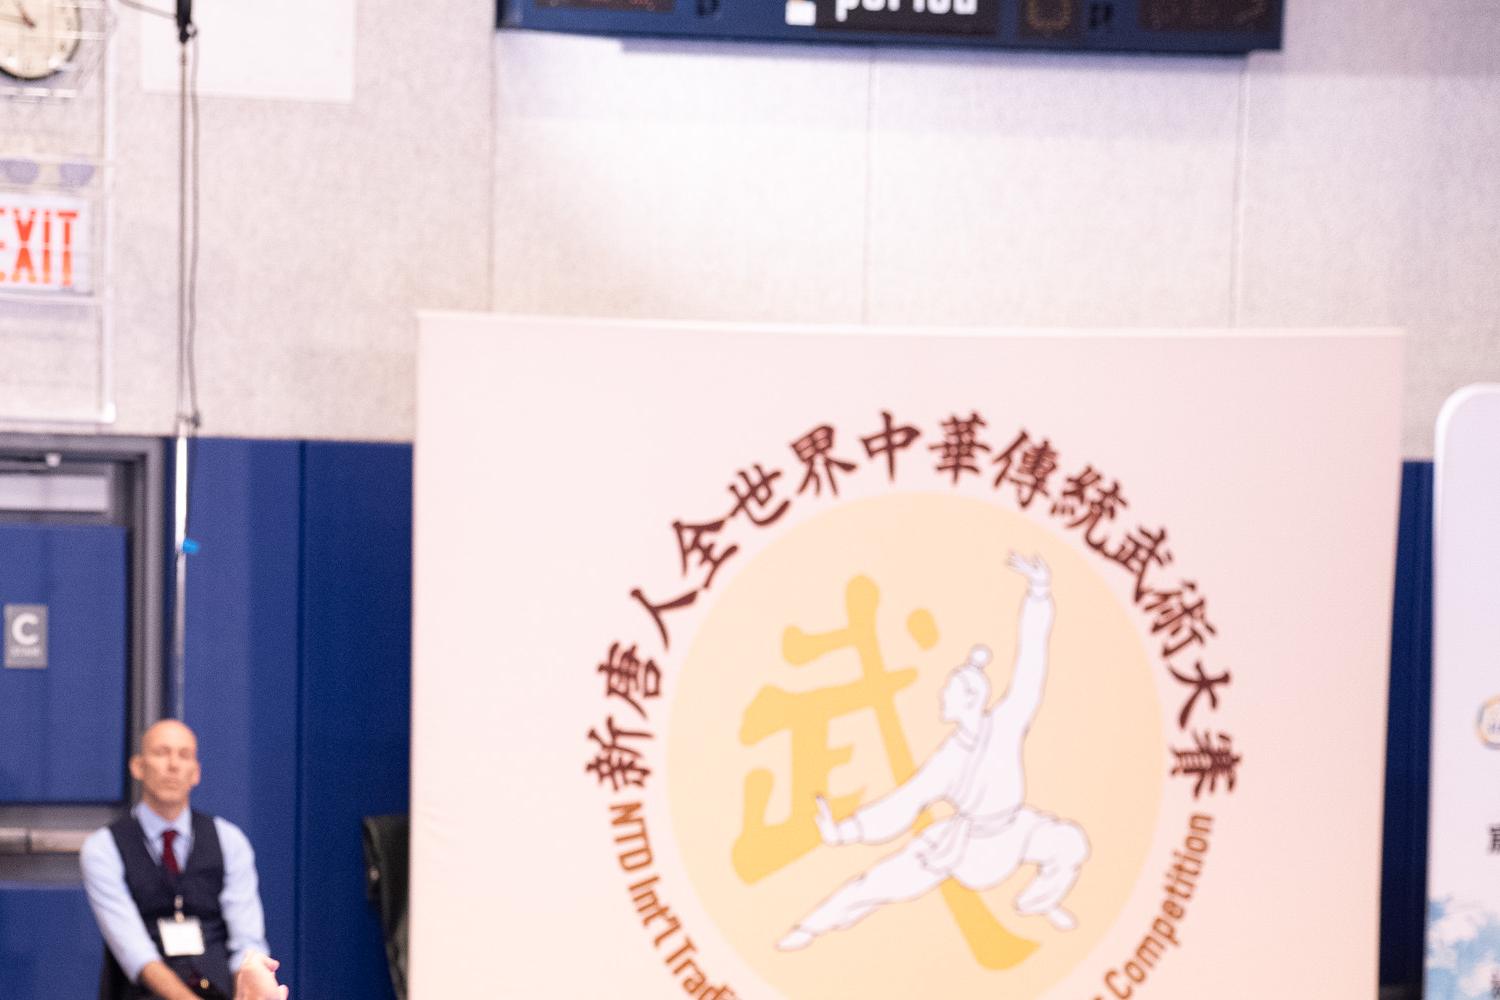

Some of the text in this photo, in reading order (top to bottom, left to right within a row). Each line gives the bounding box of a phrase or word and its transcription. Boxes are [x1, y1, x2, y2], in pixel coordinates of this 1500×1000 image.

[12, 613, 39, 646] C
[586, 409, 1243, 799] 新唐人全世界中華傳統武術大賽
[609, 801, 653, 873] NTD
